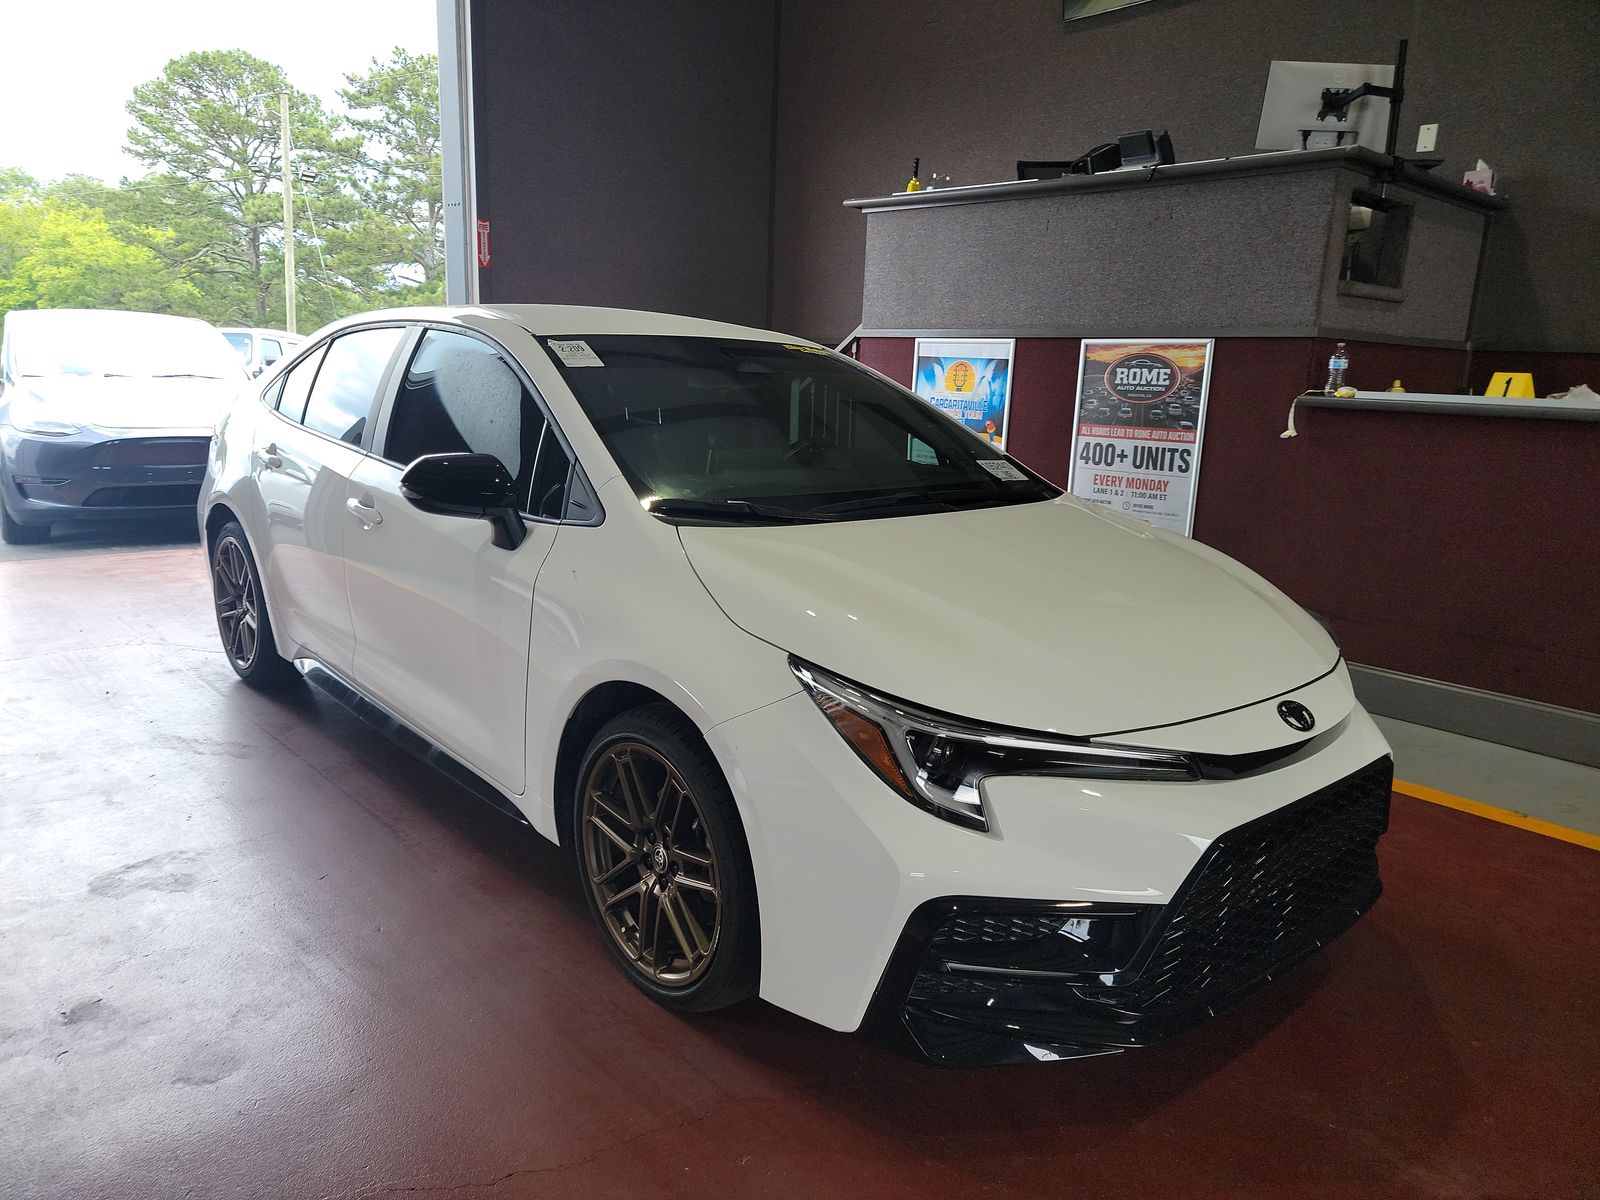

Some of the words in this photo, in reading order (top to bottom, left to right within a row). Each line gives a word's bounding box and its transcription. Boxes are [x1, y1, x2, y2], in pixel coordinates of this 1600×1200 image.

[1115, 367, 1171, 385] ROME
[1502, 377, 1513, 397] 1
[1081, 426, 1091, 435] ALL
[1091, 427, 1110, 436] ROADS
[1110, 428, 1126, 437] LEAD
[1126, 429, 1133, 438] TO
[1134, 430, 1151, 439] ROME
[1151, 430, 1168, 440] AUTO
[1168, 431, 1195, 442] AUCTION
[1079, 441, 1129, 467] 400+
[1132, 445, 1192, 474] UNITS
[1093, 474, 1124, 488] EVERY
[1125, 477, 1170, 492] MONDAY
[1093, 487, 1108, 495] LANE
[1114, 488, 1119, 496] &
[1131, 491, 1147, 499] 11:00
[1147, 492, 1158, 500] AM
[1159, 493, 1168, 501] ET
